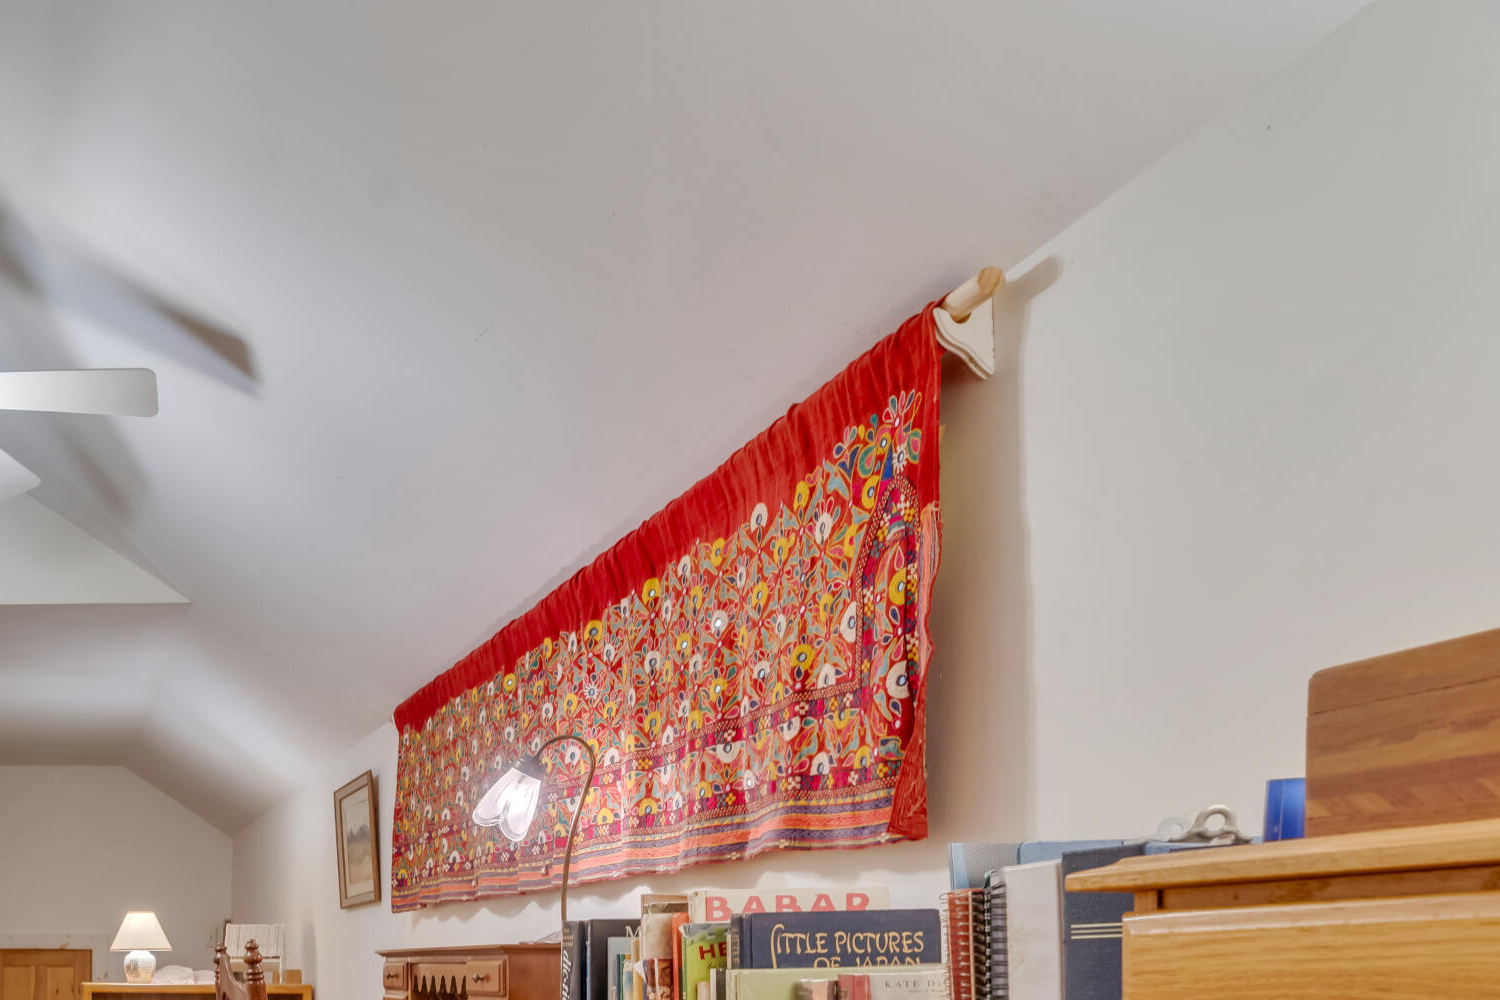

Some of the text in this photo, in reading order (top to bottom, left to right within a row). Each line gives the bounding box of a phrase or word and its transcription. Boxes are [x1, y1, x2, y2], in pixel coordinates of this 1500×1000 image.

[706, 893, 870, 921] BABAR
[834, 931, 924, 954] PICTURES
[886, 980, 917, 988] KATE
